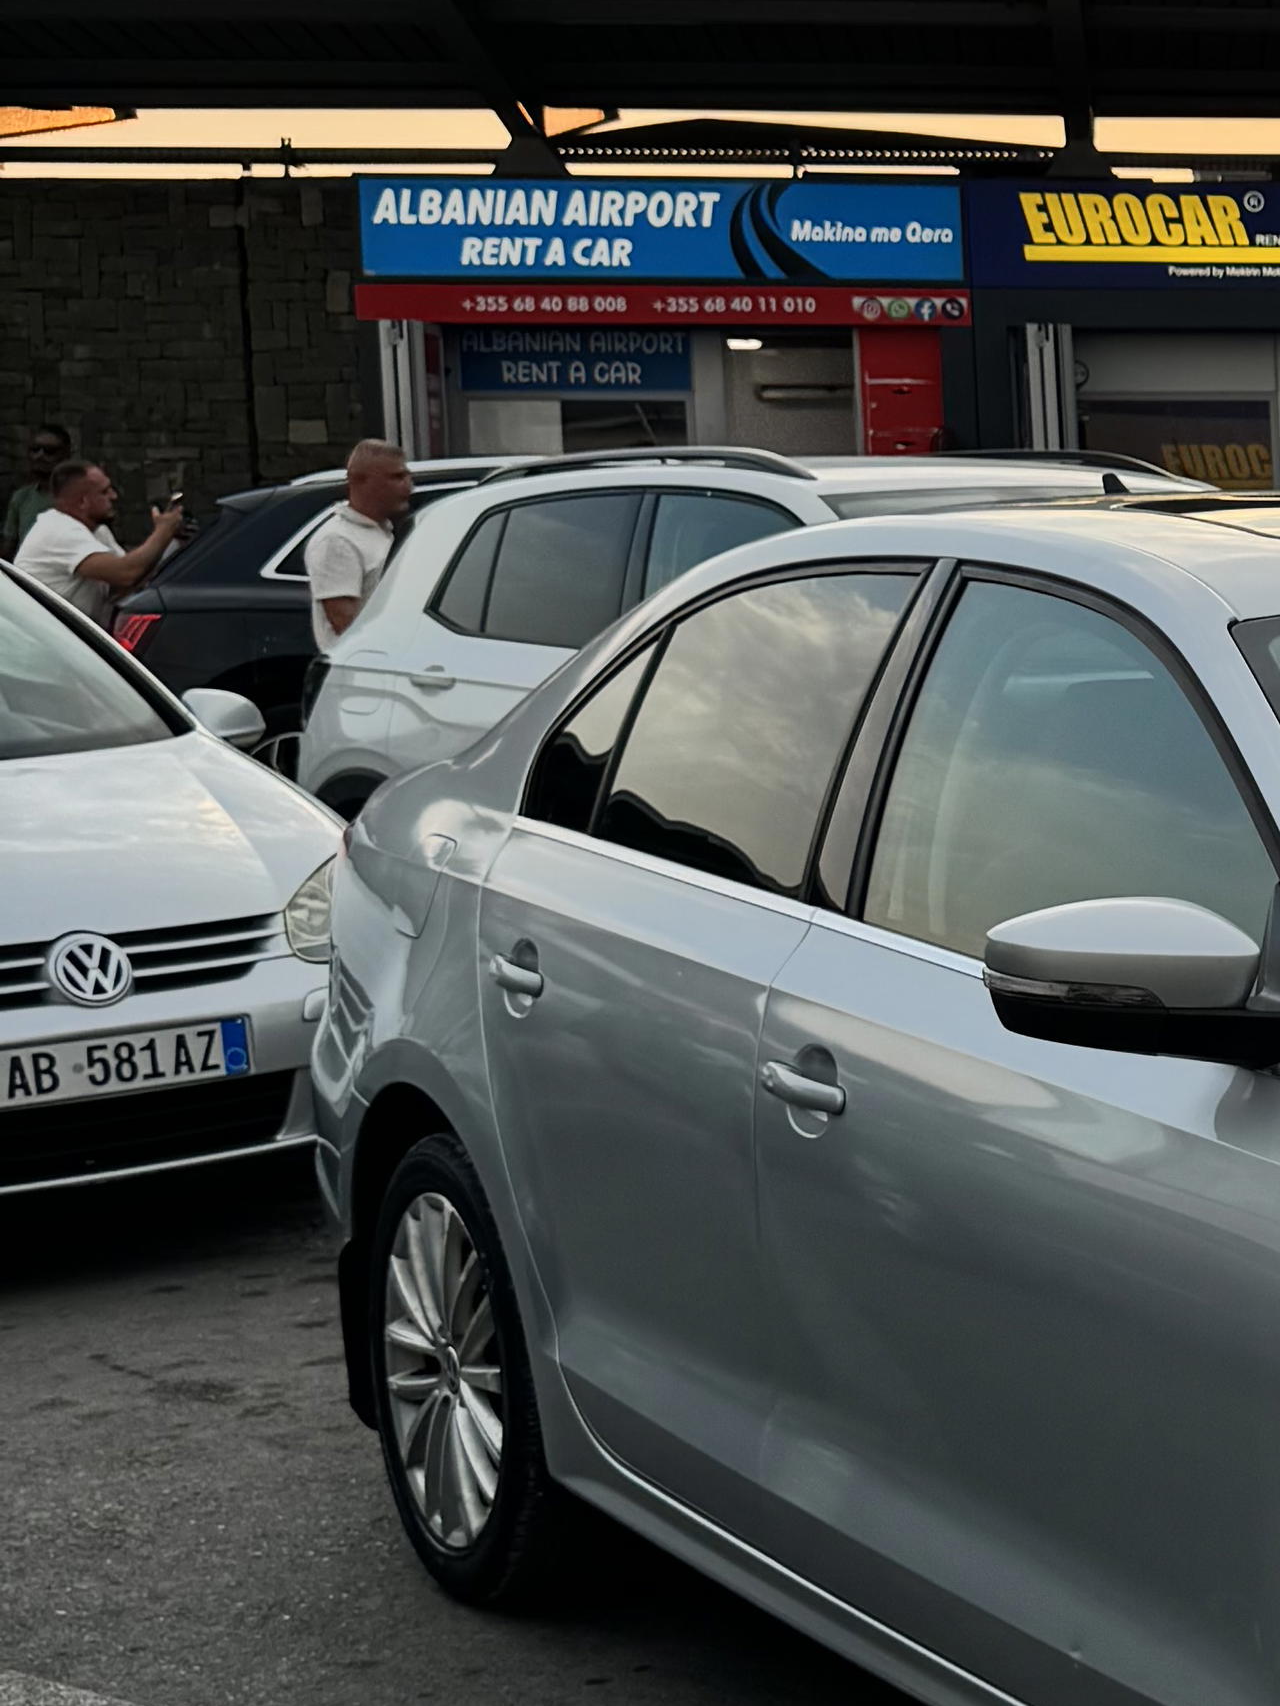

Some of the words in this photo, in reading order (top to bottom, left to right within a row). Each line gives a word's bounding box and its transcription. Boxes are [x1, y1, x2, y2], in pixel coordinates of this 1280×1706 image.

[372, 188, 558, 226] ALBANIAN
[563, 191, 721, 229] AIRPORT
[1019, 192, 1249, 246] EUROCAR
[791, 219, 867, 243] Makina
[460, 237, 543, 266] RENT
[544, 238, 565, 266] A
[572, 238, 633, 267] CAR
[461, 296, 508, 312] +355
[513, 296, 535, 312] 68
[540, 297, 563, 312] 40
[652, 296, 699, 313] +355
[704, 297, 726, 313] 68
[731, 297, 752, 313] 40
[758, 297, 777, 313] 11
[783, 297, 816, 313] 010
[462, 331, 581, 354] ALBANIAN
[589, 332, 686, 355] AIRPORT
[502, 361, 560, 384] RENT
[569, 362, 587, 384] A
[594, 362, 641, 385] CAR
[8, 1052, 60, 1099] AB
